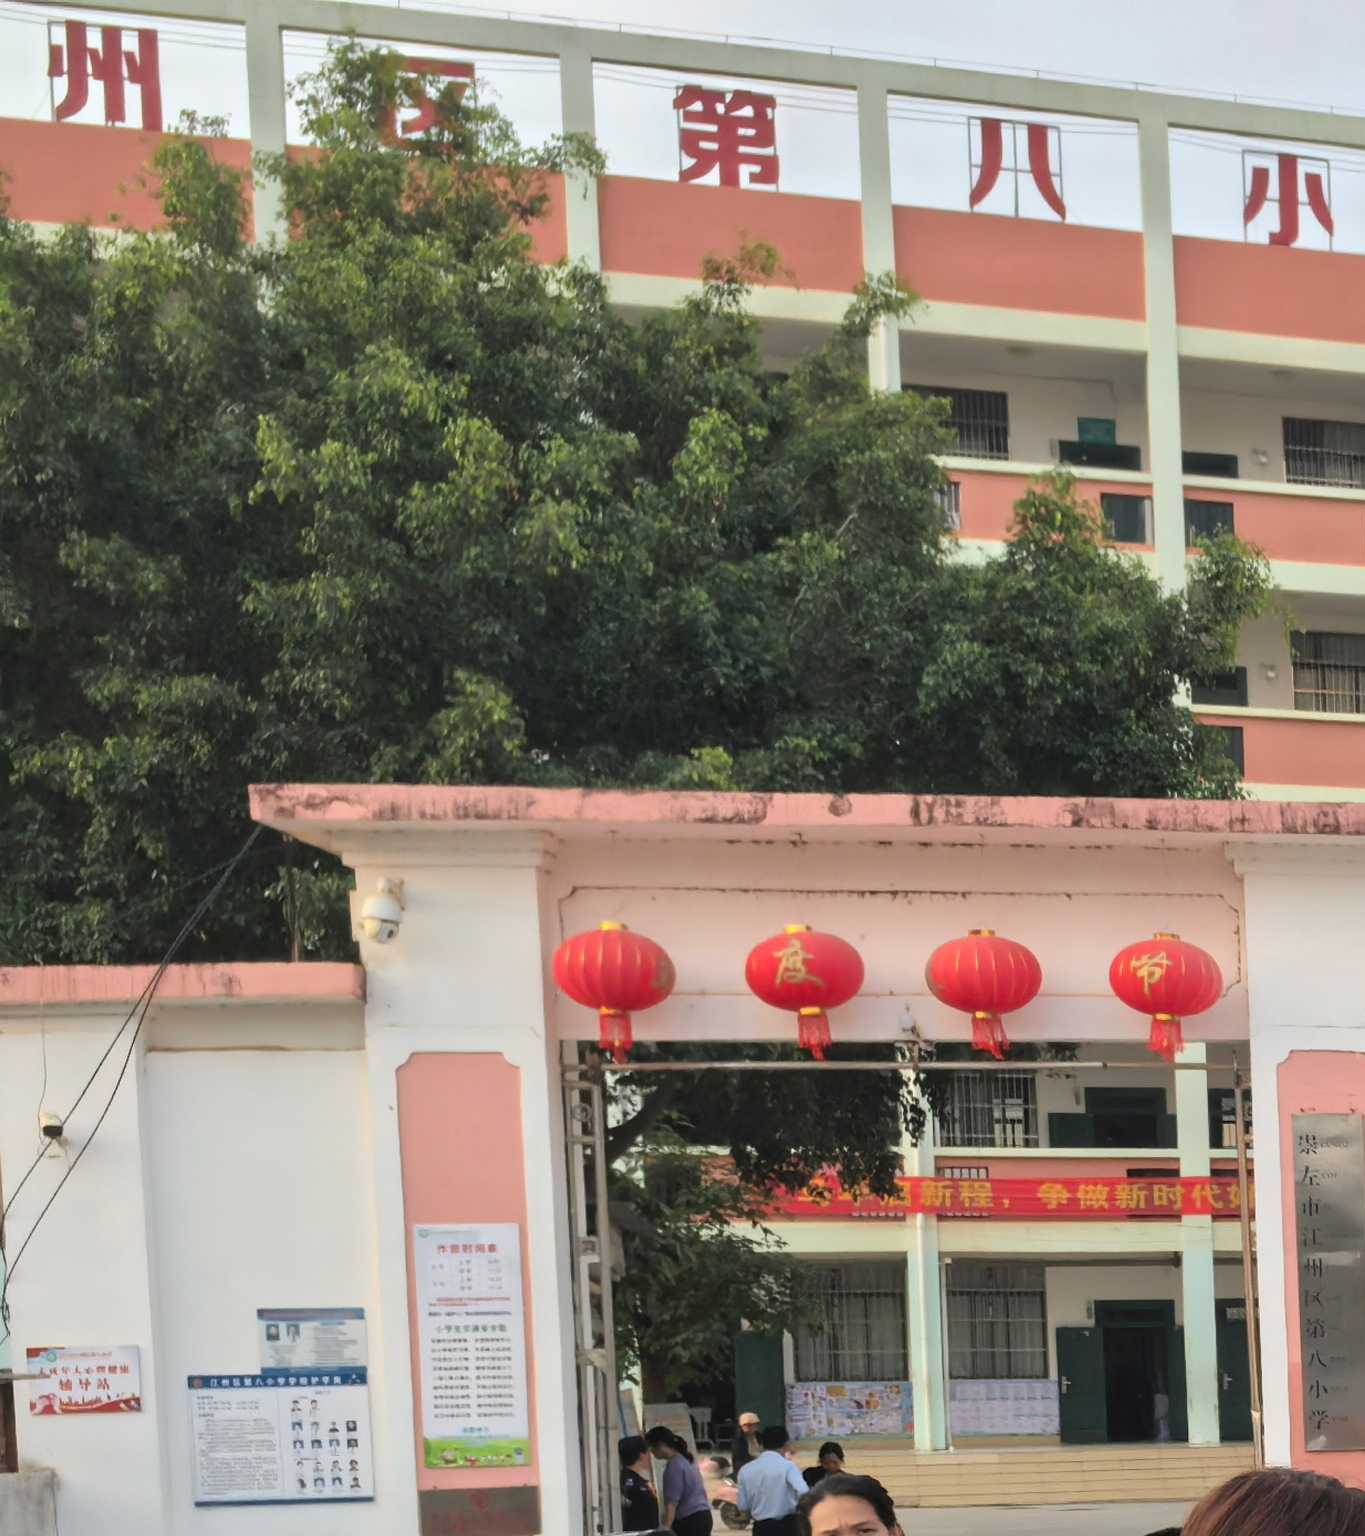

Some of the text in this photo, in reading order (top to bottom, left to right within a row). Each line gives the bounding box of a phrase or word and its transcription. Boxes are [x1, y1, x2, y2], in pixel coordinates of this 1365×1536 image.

[772, 942, 825, 990] 度
[1130, 951, 1169, 998] 节
[1298, 1132, 1331, 1431] 崇左市江州区第八小学
